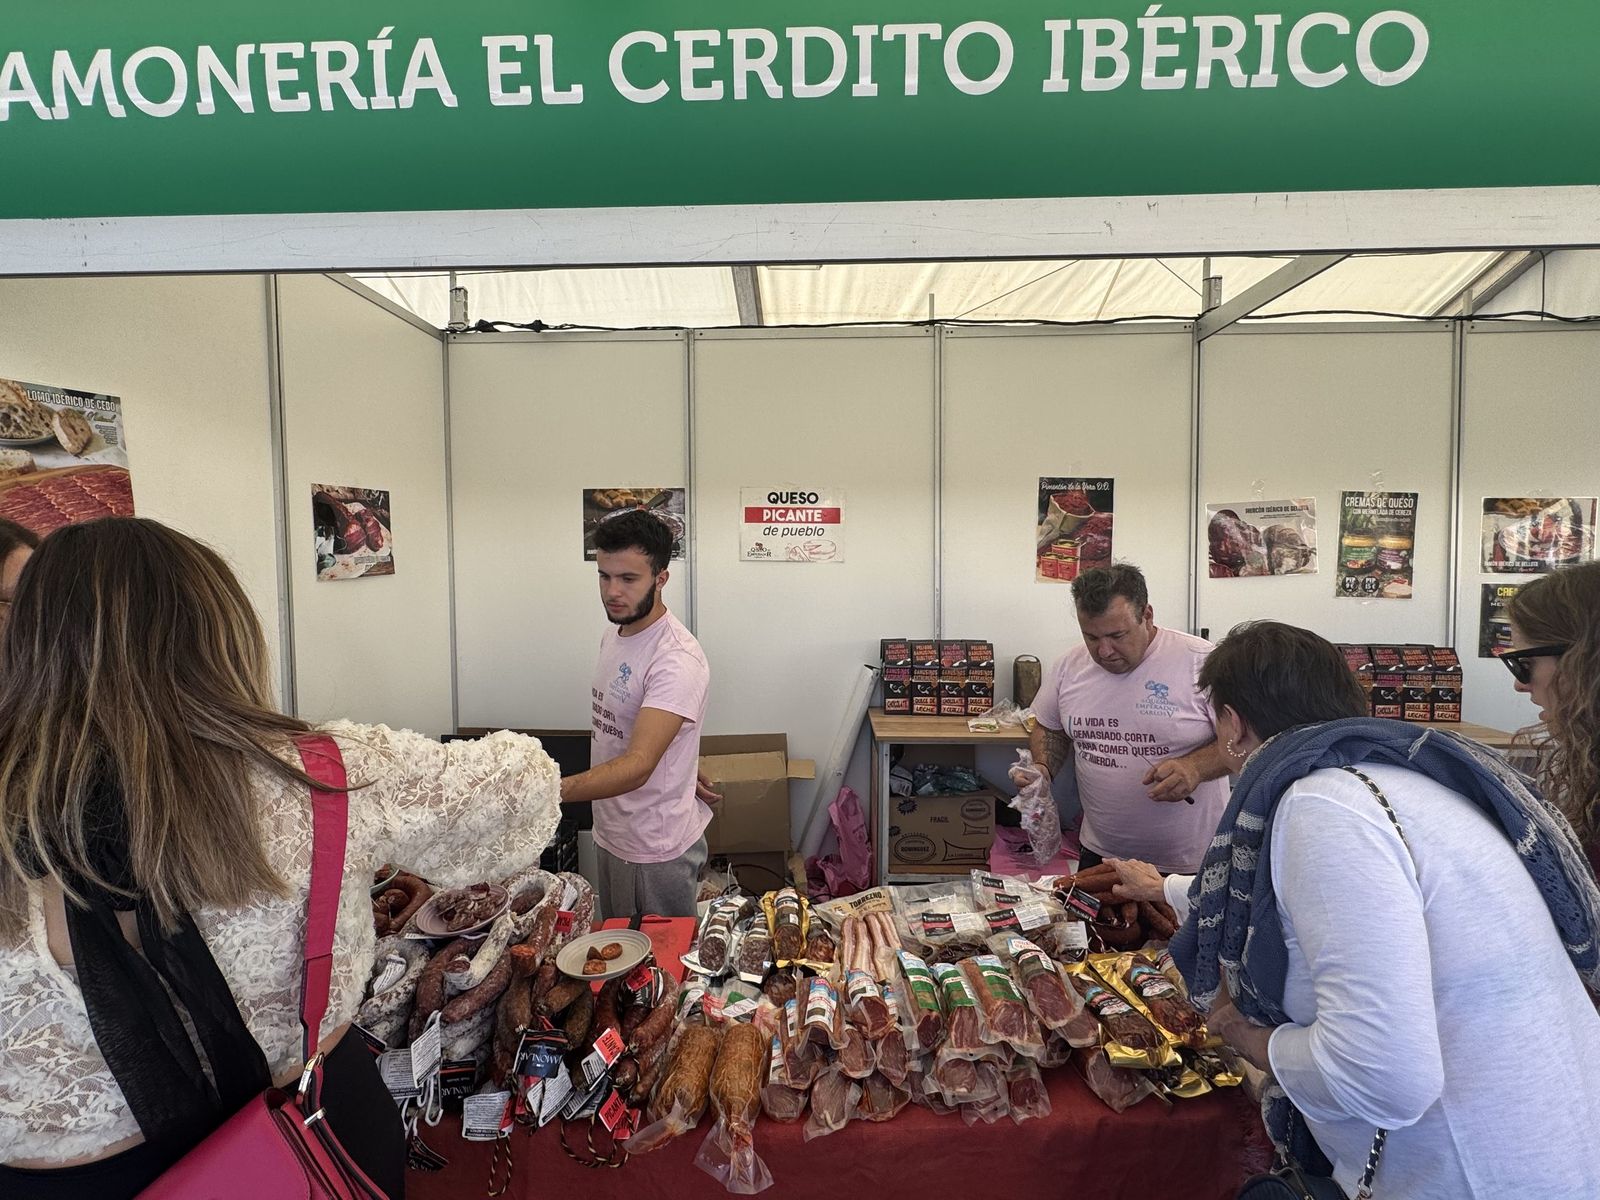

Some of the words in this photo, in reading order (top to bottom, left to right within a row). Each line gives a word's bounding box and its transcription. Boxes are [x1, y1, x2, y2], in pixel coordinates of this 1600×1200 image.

[481, 34, 584, 105] EL
[608, 21, 1014, 104] CERDITO
[1042, 4, 1430, 93] IBÉRICO
[27, 389, 51, 402] LOMO
[85, 398, 96, 409] DE
[96, 400, 116, 412] CEBO
[767, 491, 819, 504] QUESO
[1345, 496, 1375, 508] CREMAS
[1376, 497, 1387, 508] DE
[1388, 497, 1414, 509] QUESO
[762, 508, 823, 522] PICANTE
[763, 525, 779, 537] de
[781, 525, 825, 538] pueblo
[1073, 717, 1082, 726] LA
[1085, 717, 1105, 727] VIDA
[1108, 718, 1119, 727] ES
[1073, 729, 1121, 741] DEMASIADO
[1124, 732, 1156, 743] CORTA
[1077, 741, 1097, 751] PARA
[1098, 743, 1128, 755] COMER
[1131, 746, 1170, 757] QUESOS
